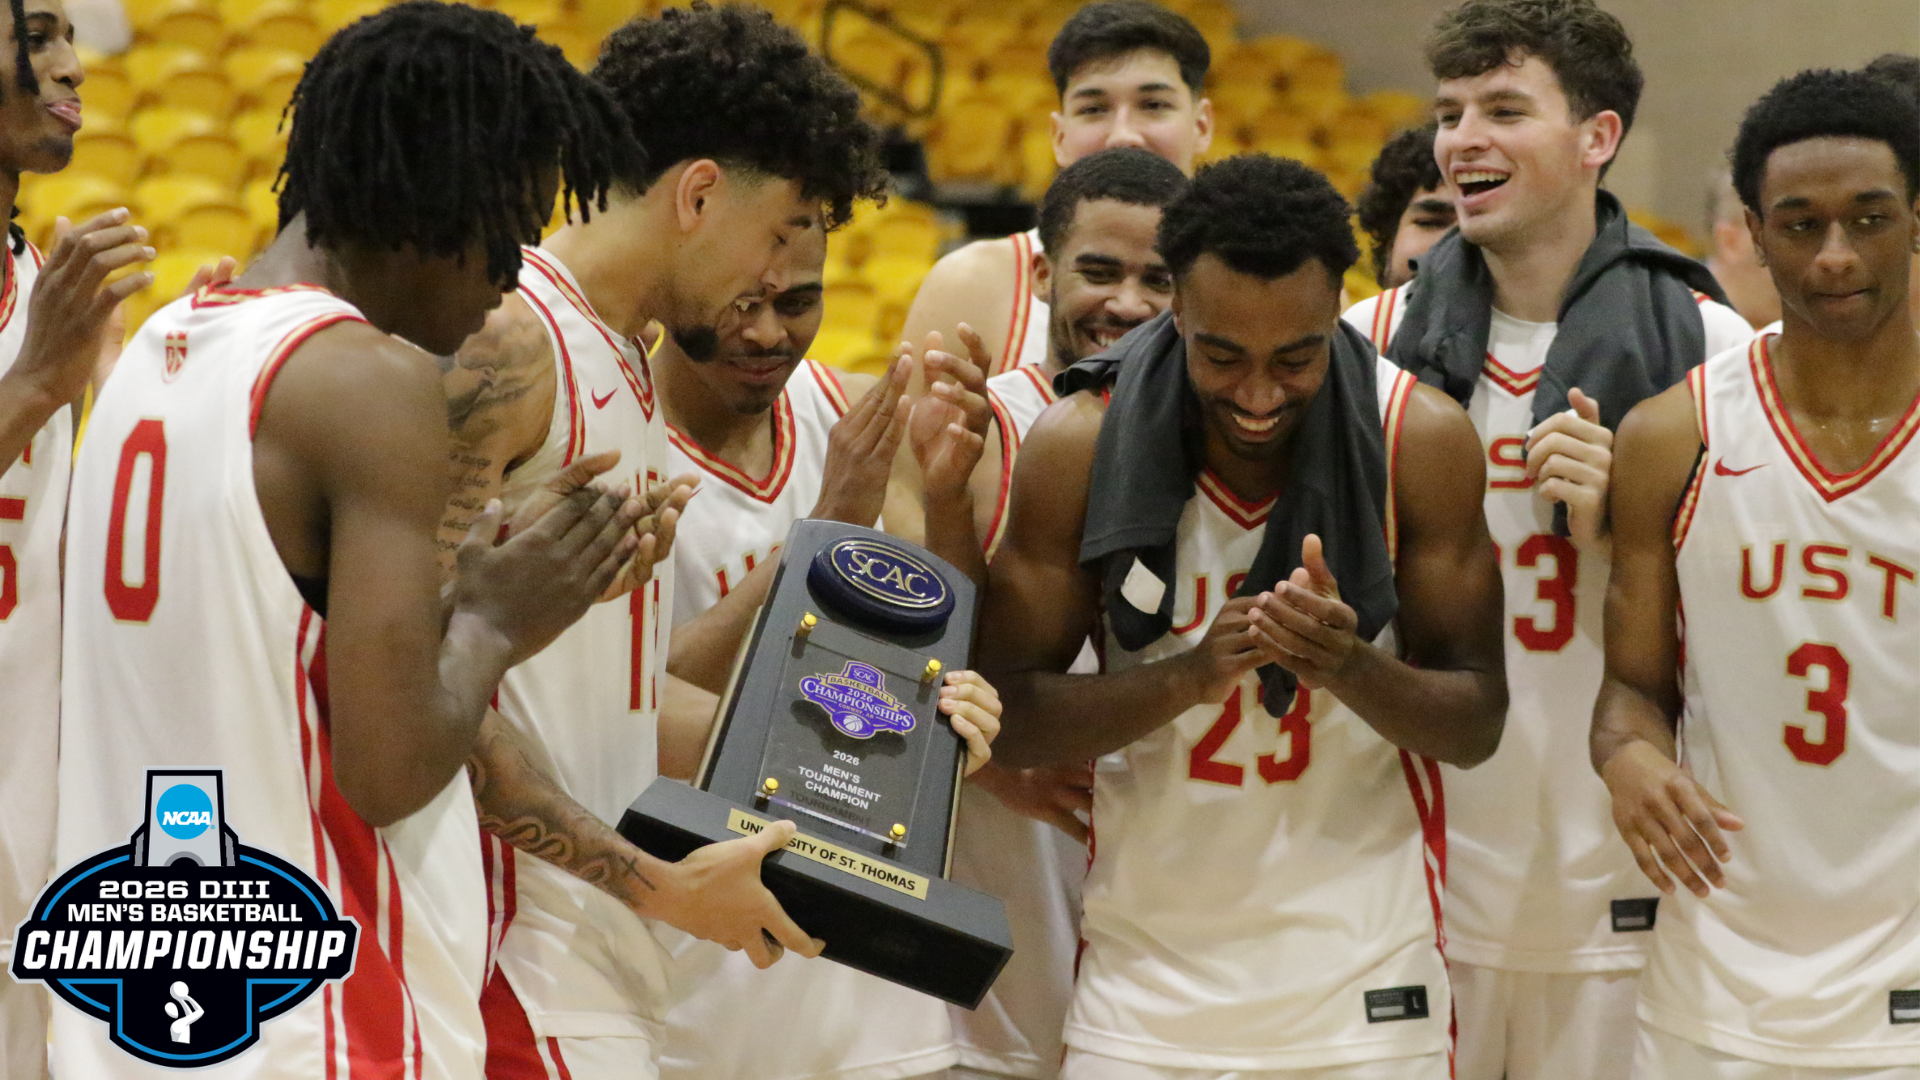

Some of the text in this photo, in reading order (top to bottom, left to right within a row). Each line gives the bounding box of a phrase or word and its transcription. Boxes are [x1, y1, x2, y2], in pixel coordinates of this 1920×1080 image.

[104, 417, 168, 625] 0
[848, 551, 929, 597] SCAC
[1740, 540, 1916, 622] UST
[830, 677, 891, 704] BASKETBALL
[847, 688, 873, 702] 2026
[853, 669, 875, 681] SCAC
[804, 680, 912, 727] CHAMPIONSHIPS
[1782, 642, 1851, 767] 3
[1188, 682, 1312, 788] 23
[823, 764, 861, 783] MEN'S
[832, 750, 860, 766] 2026
[798, 766, 881, 802] TOURNAMENT
[805, 781, 869, 809] CHAMPION
[740, 819, 817, 854] UNSITY
[820, 848, 838, 861] OF
[839, 856, 857, 870] ST.
[861, 862, 916, 891] THOMAS
